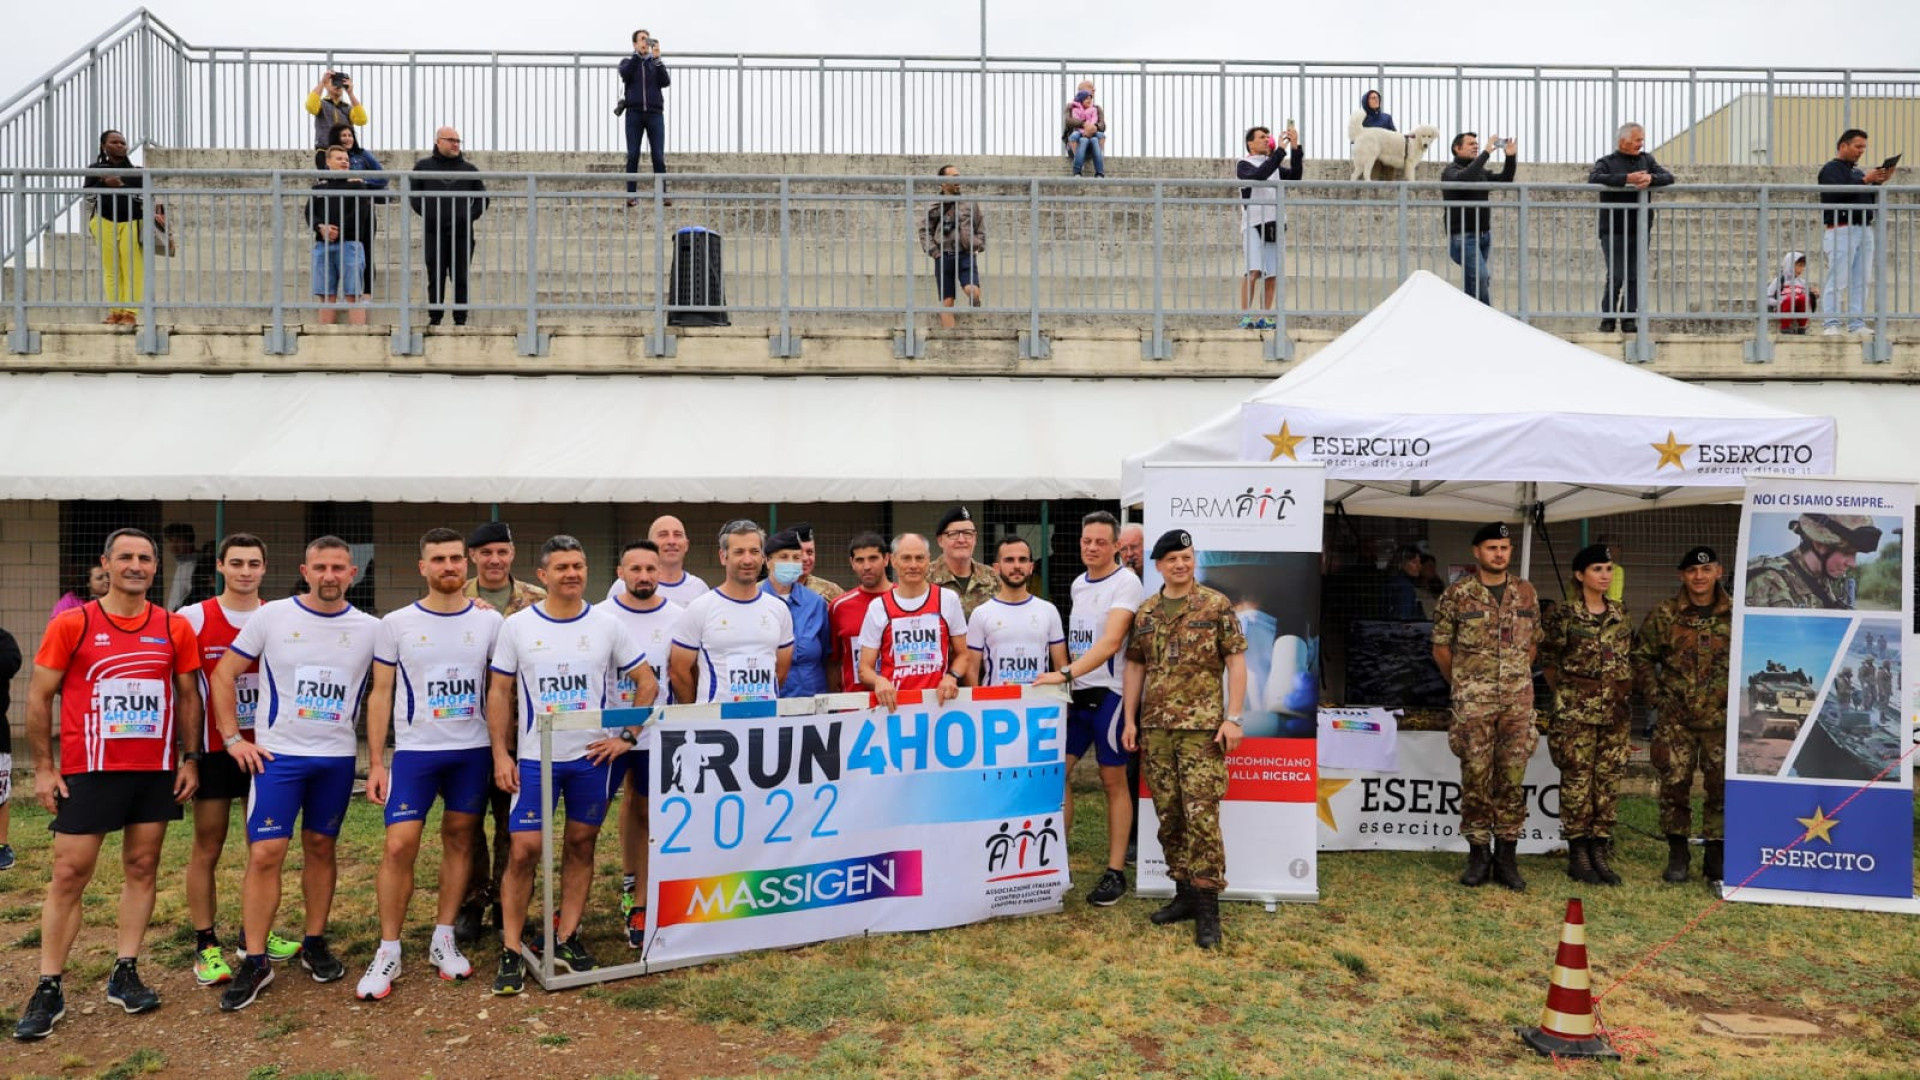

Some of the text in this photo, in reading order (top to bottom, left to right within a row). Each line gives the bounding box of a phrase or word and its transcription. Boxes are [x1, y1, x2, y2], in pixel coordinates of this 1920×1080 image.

[1311, 435, 1431, 457] ESERCITO
[1697, 443, 1813, 464] ESERCITO
[1752, 493, 1894, 509] NOI CI SIAMO SEMPRE...
[1223, 755, 1312, 768] RICOMINCIANO
[982, 767, 1059, 782] ITALIA
[1231, 770, 1311, 781] ALLA RICERCA
[1360, 777, 1561, 819] ESERTO
[660, 783, 839, 854] 2022
[1760, 847, 1876, 872] ESERCITO
